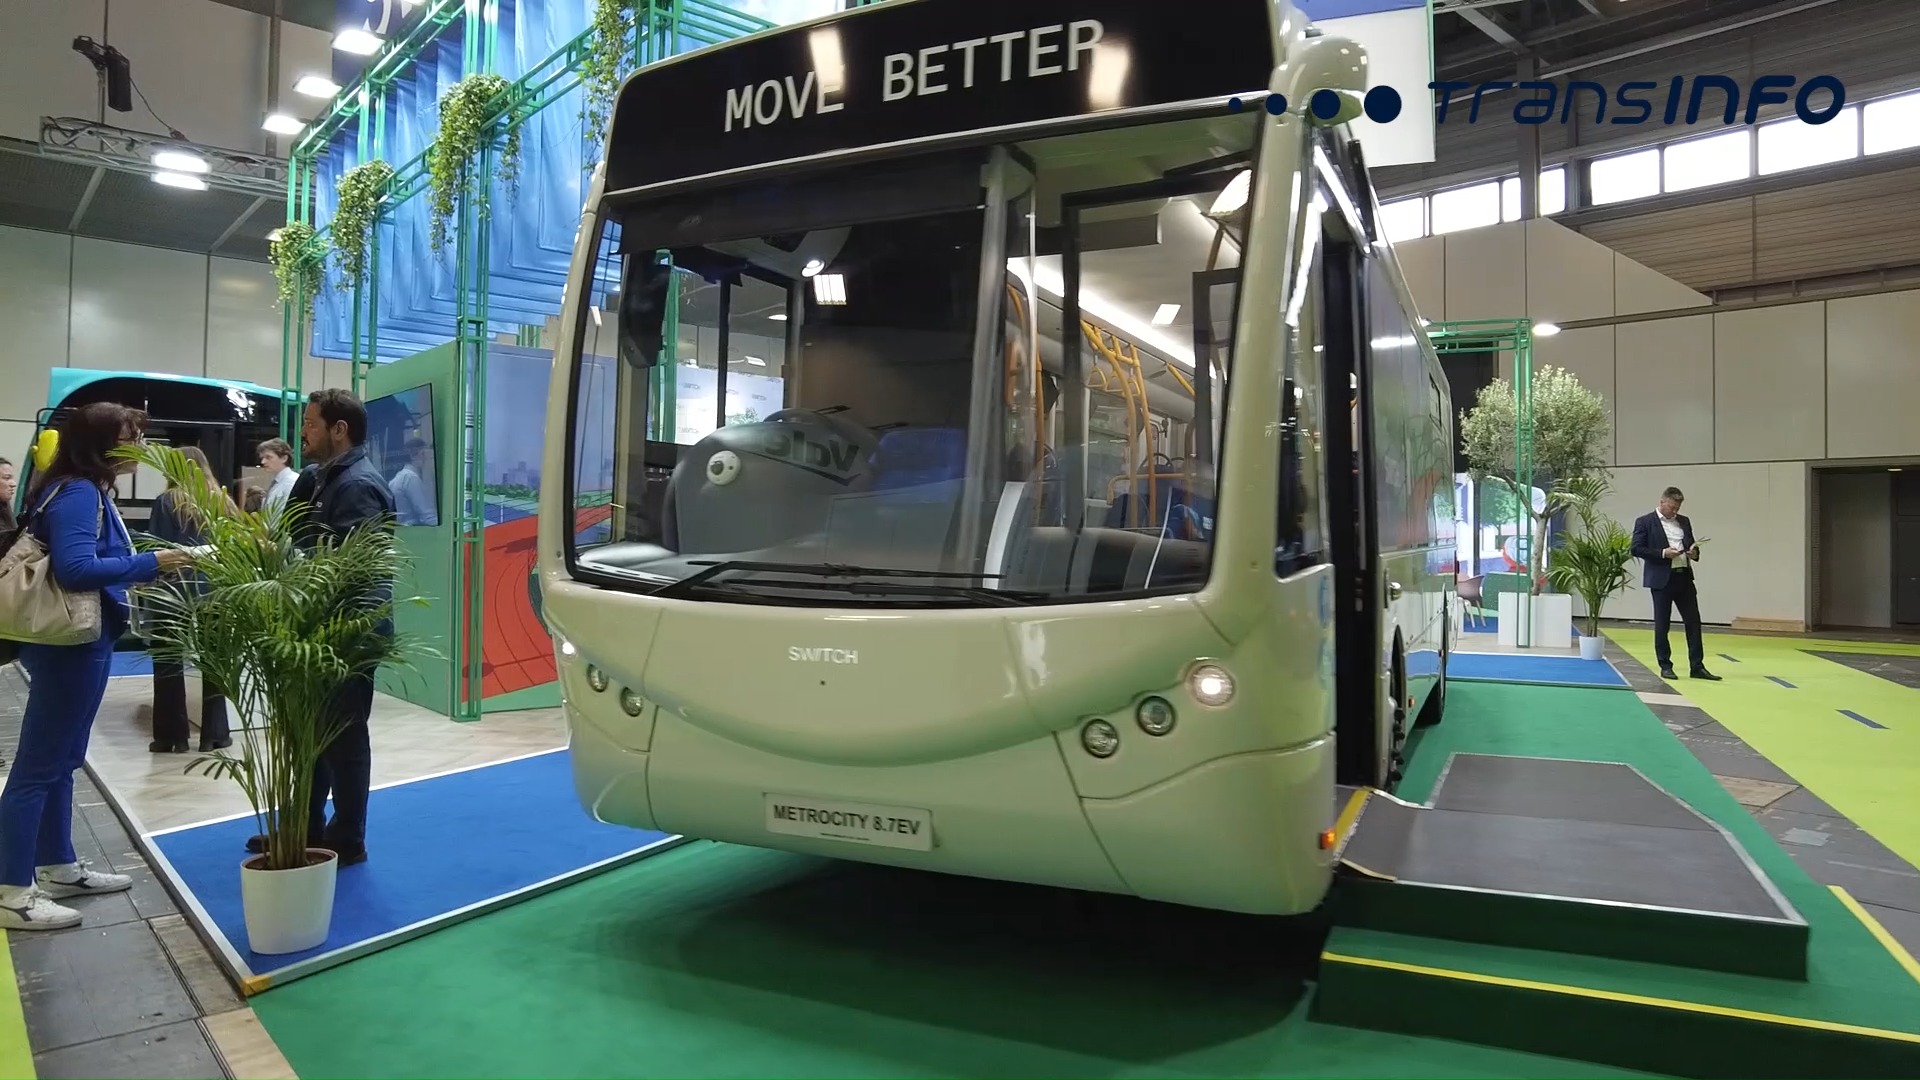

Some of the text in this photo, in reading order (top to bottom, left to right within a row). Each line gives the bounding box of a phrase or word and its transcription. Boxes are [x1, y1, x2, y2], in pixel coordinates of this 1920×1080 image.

[724, 19, 1105, 132] MOVE BETTER
[788, 645, 859, 665] SWITCH
[773, 804, 921, 835] METROCITY 8.7EV
